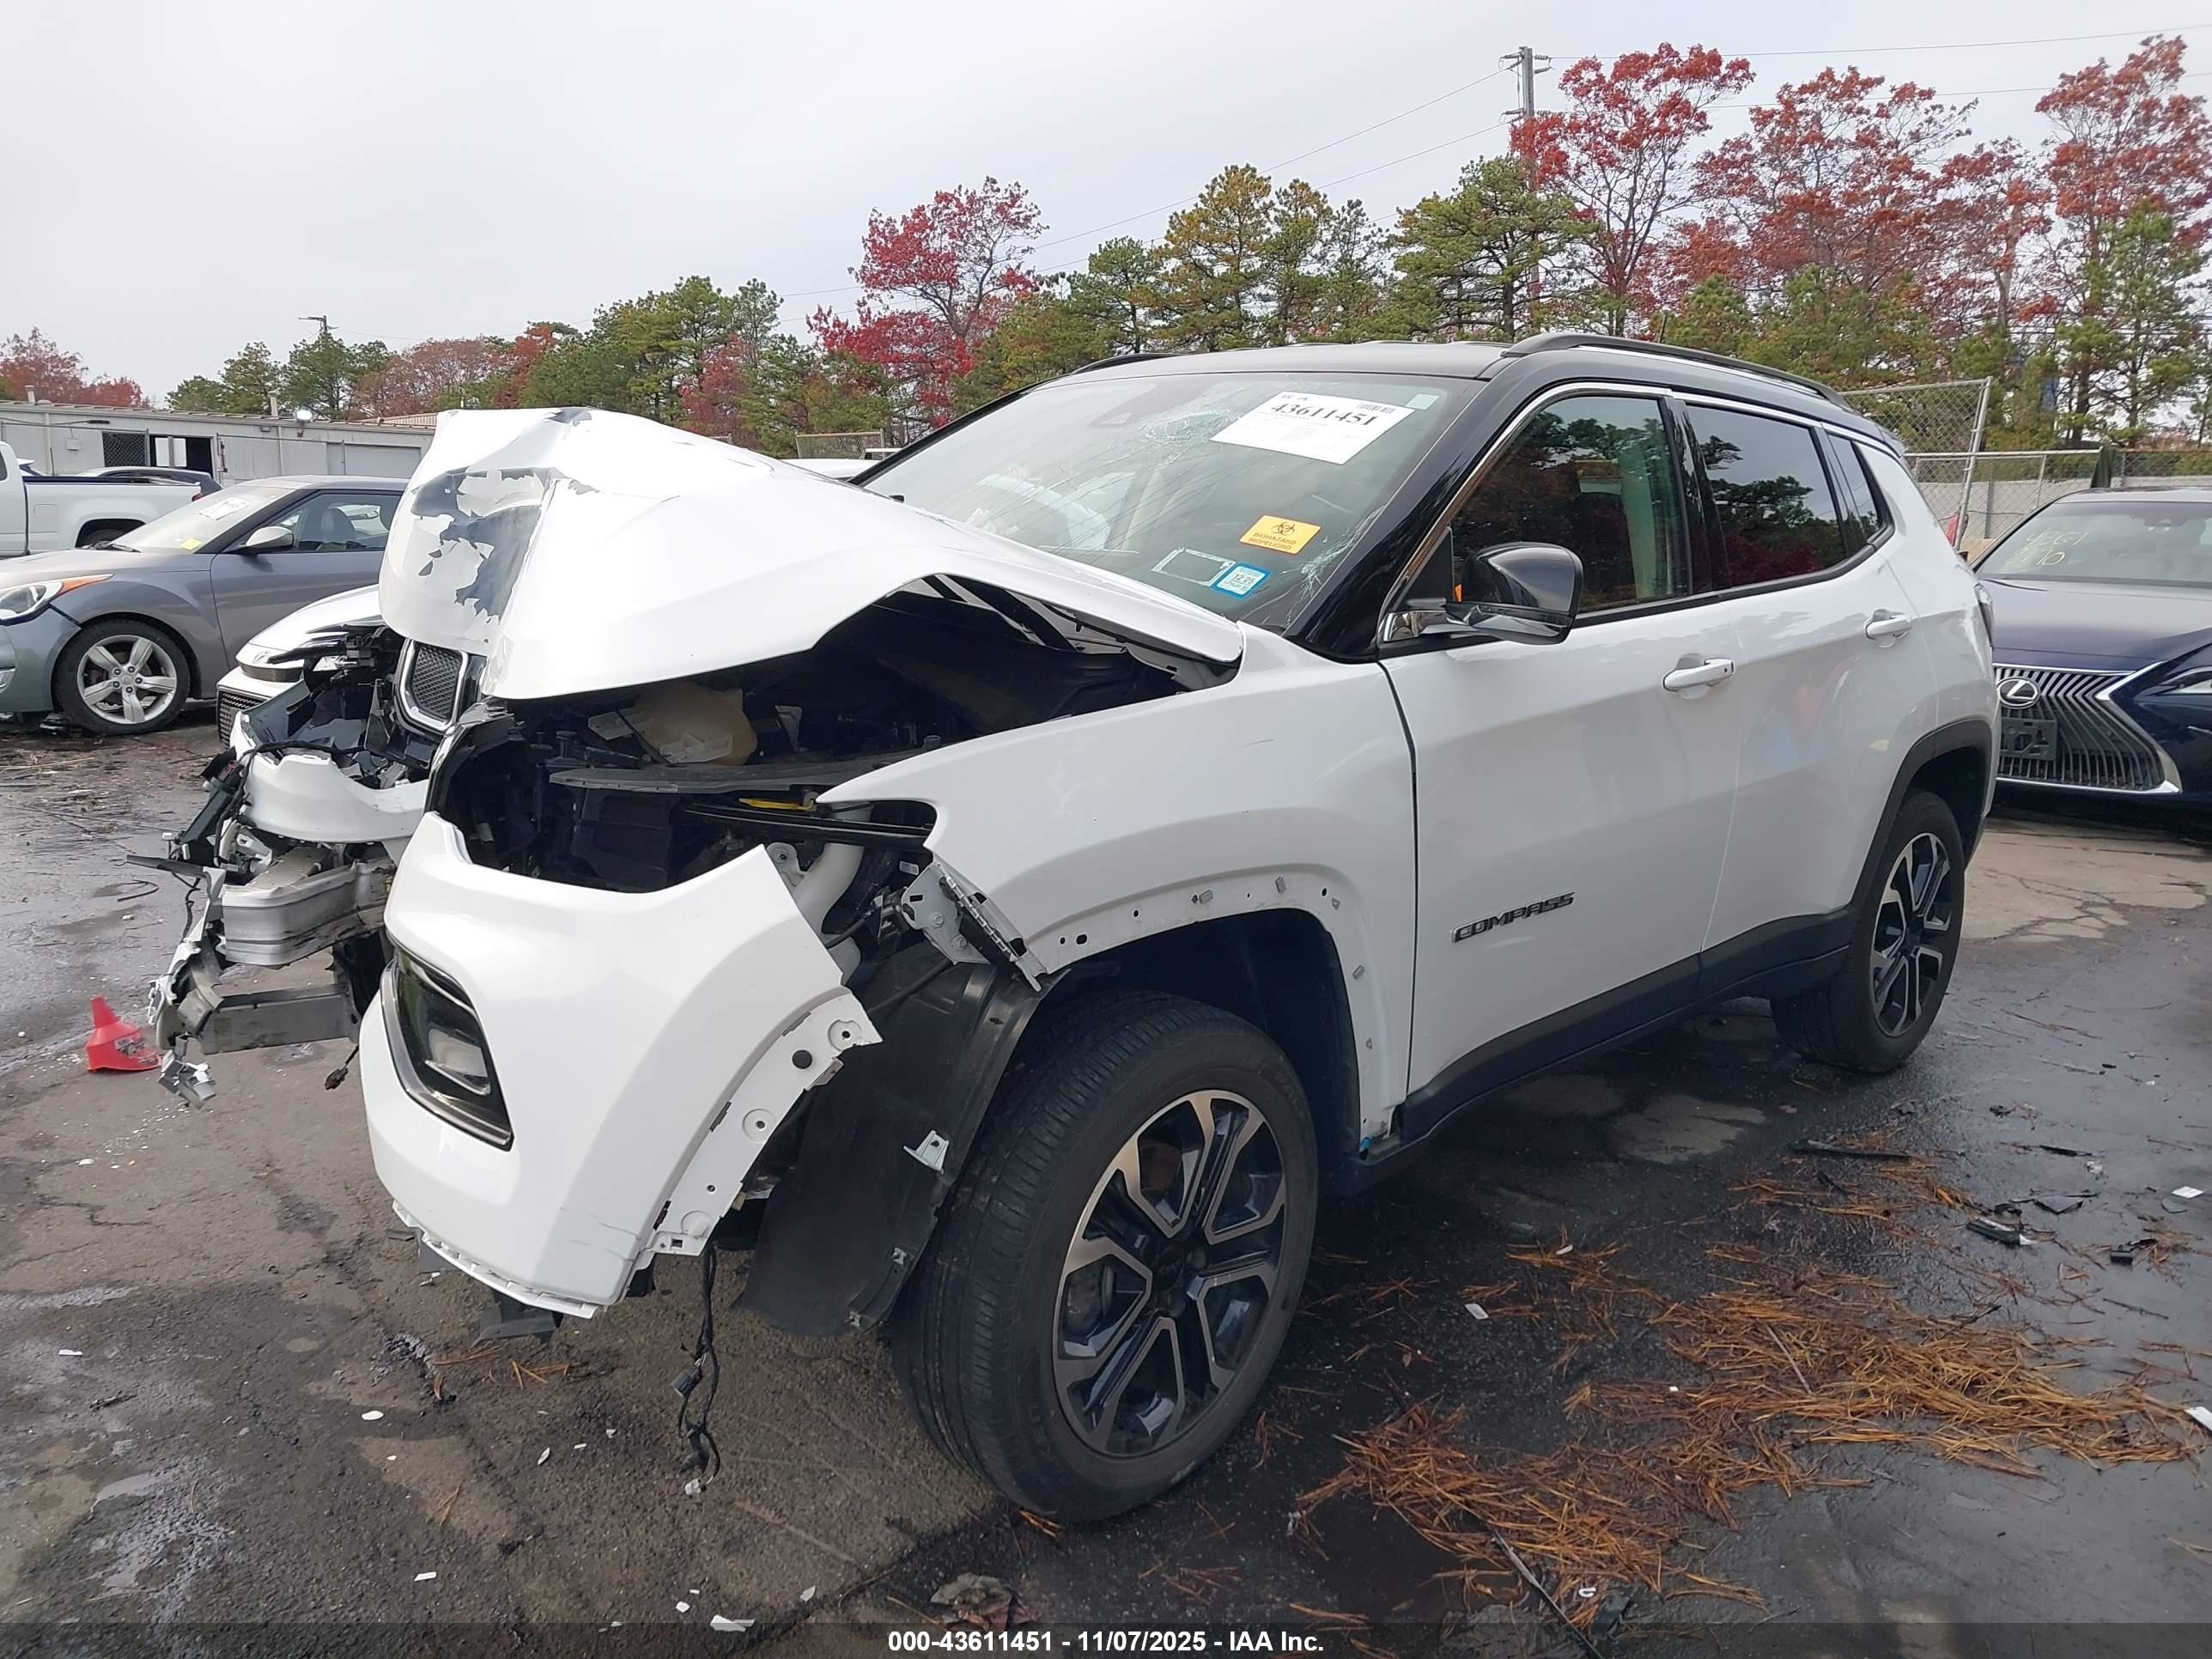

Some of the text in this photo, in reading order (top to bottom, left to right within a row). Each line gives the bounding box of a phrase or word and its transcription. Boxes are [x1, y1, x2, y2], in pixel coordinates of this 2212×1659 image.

[1272, 403, 1377, 426] 43611451
[1253, 532, 1297, 545] BIOHAZARD
[1452, 890, 1576, 943] COMPASS
